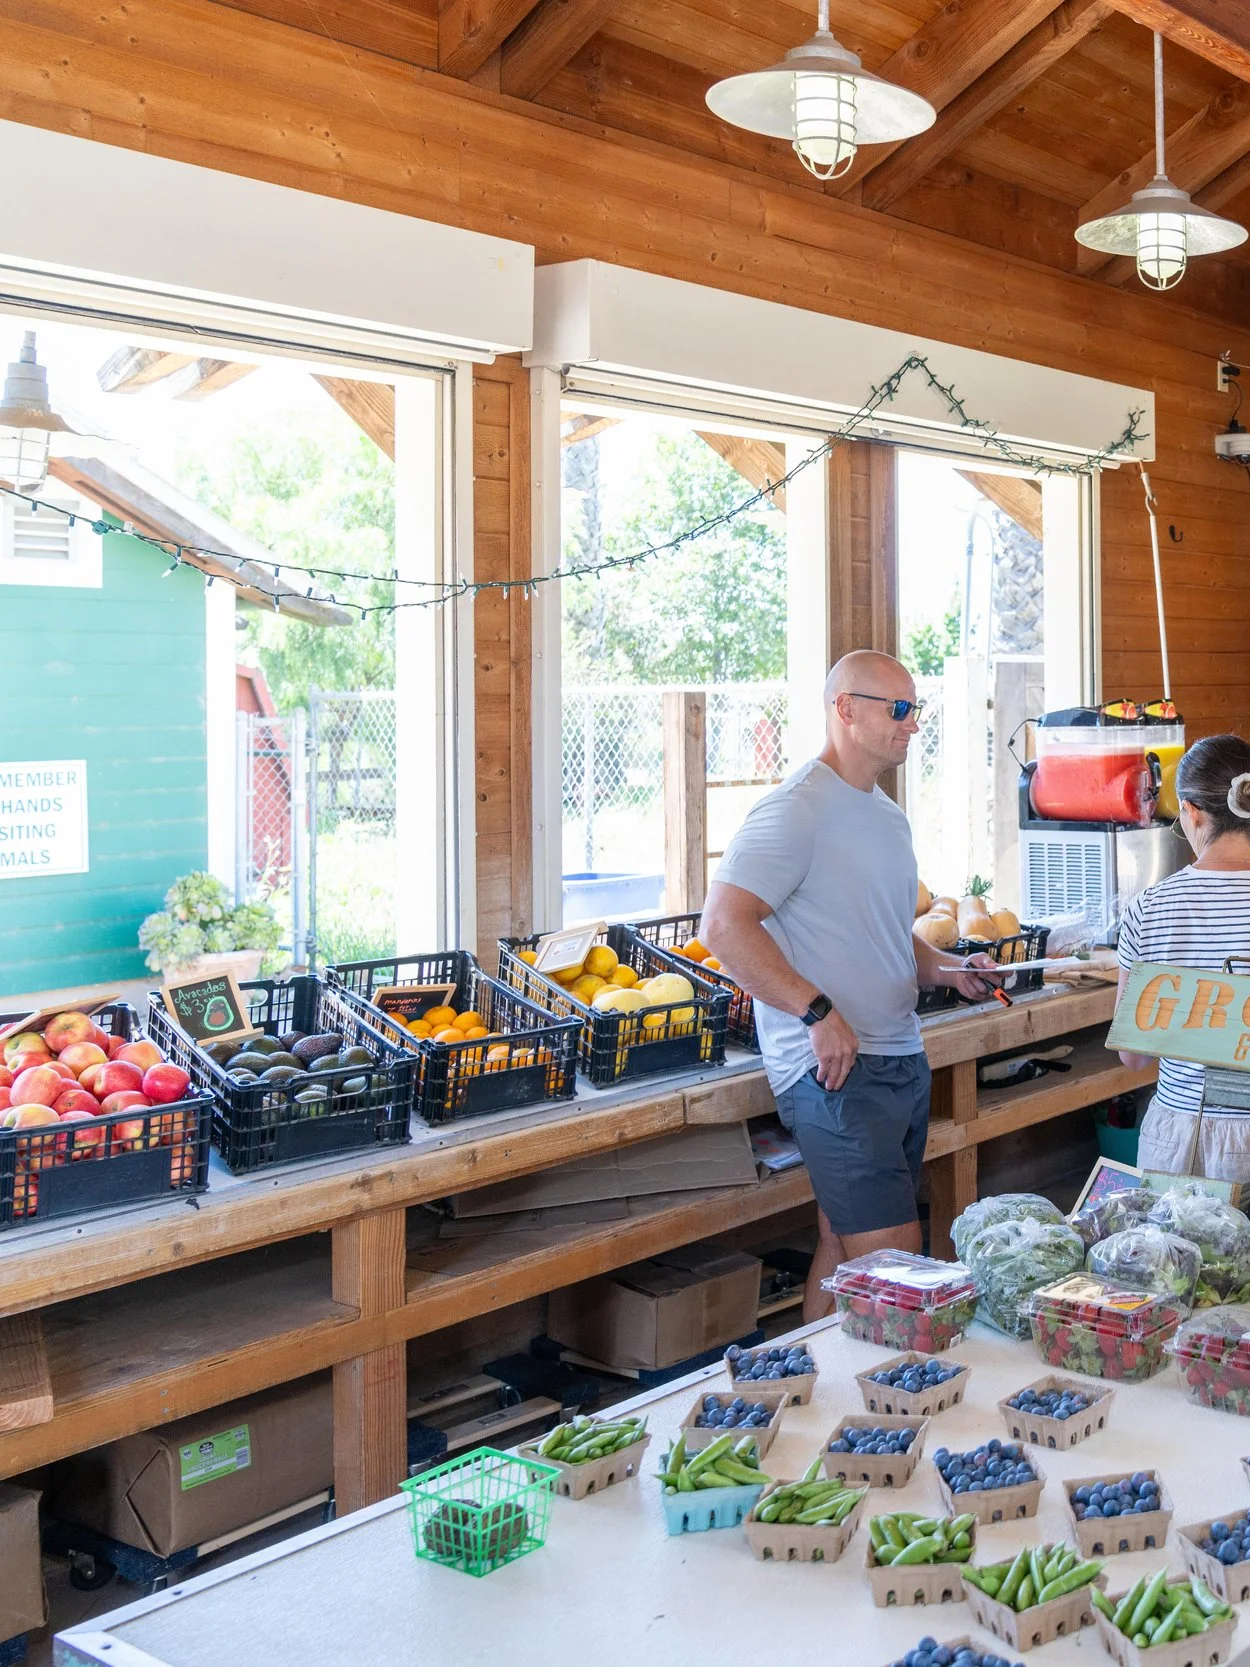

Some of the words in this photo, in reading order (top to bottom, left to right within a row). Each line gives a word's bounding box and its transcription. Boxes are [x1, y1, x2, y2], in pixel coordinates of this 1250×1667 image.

[0, 771, 77, 788] MEMBER
[1, 797, 63, 815] HANDS
[1234, 1033, 1250, 1062] &
